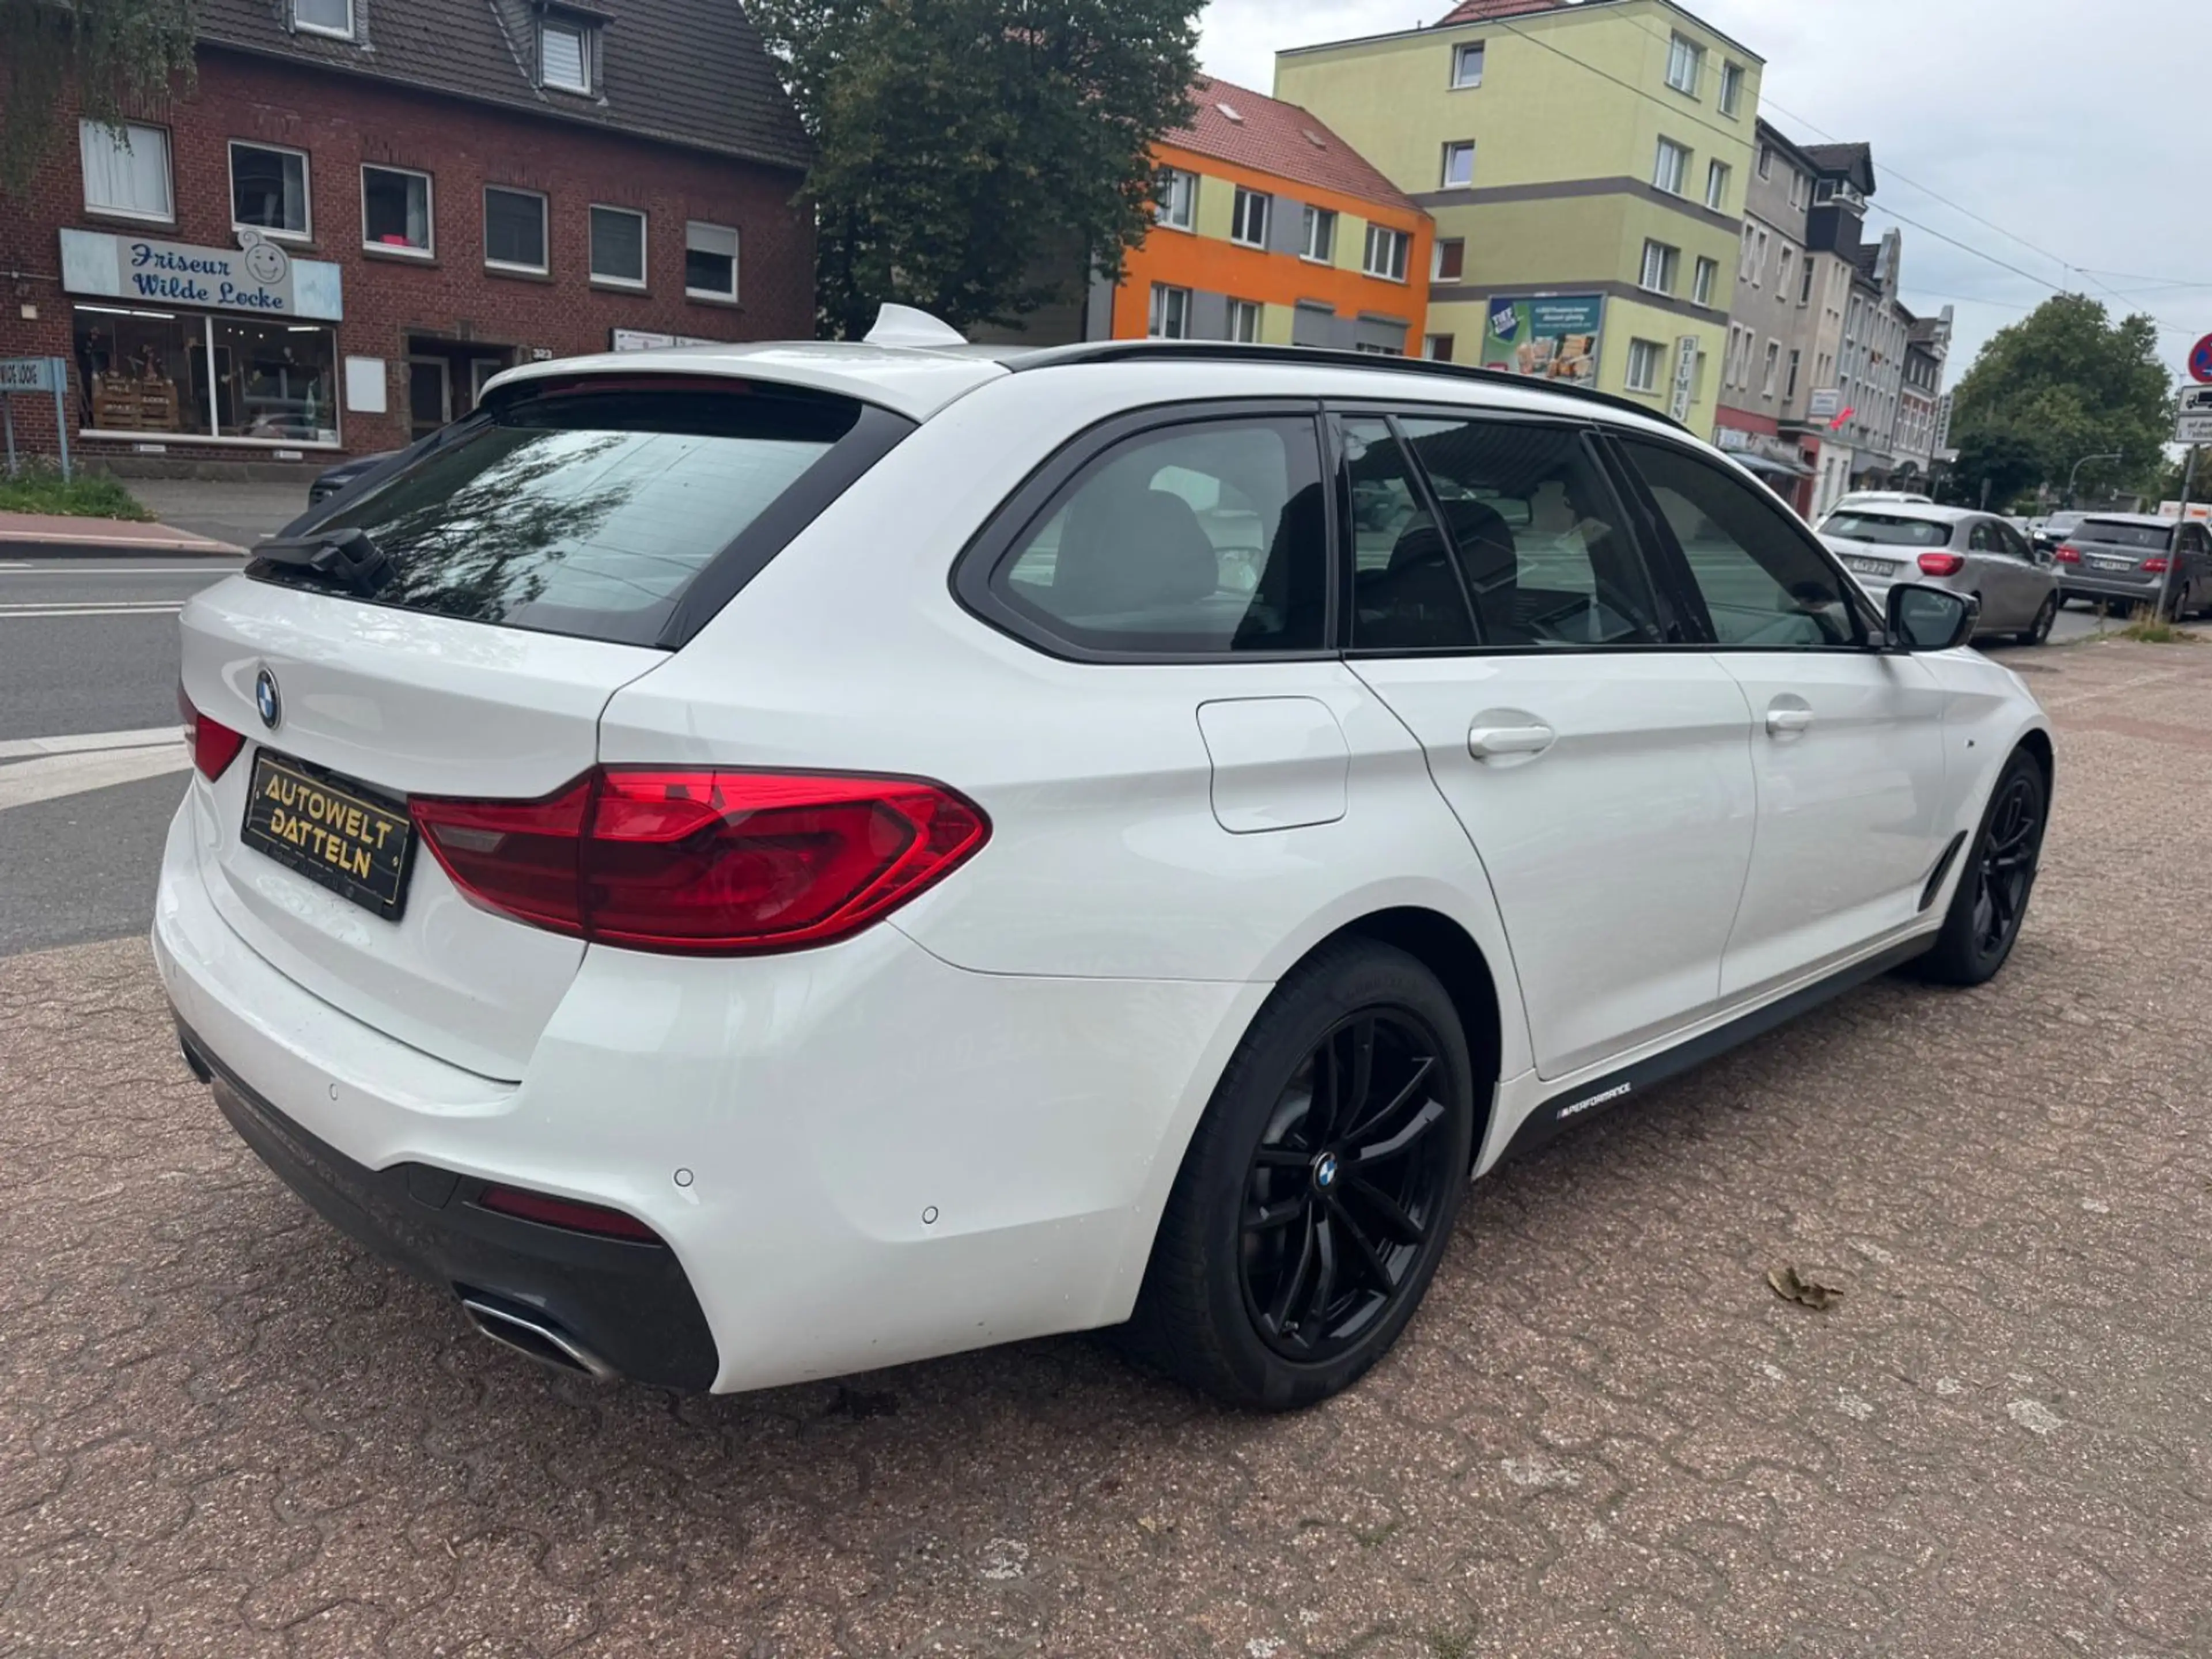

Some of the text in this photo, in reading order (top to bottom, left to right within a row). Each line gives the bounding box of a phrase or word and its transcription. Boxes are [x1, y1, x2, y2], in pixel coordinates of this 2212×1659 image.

[131, 243, 231, 276] Friseur
[132, 273, 283, 309] Wilde Locke
[265, 774, 393, 850] AUTOWELT
[271, 808, 371, 879] DATTELN
